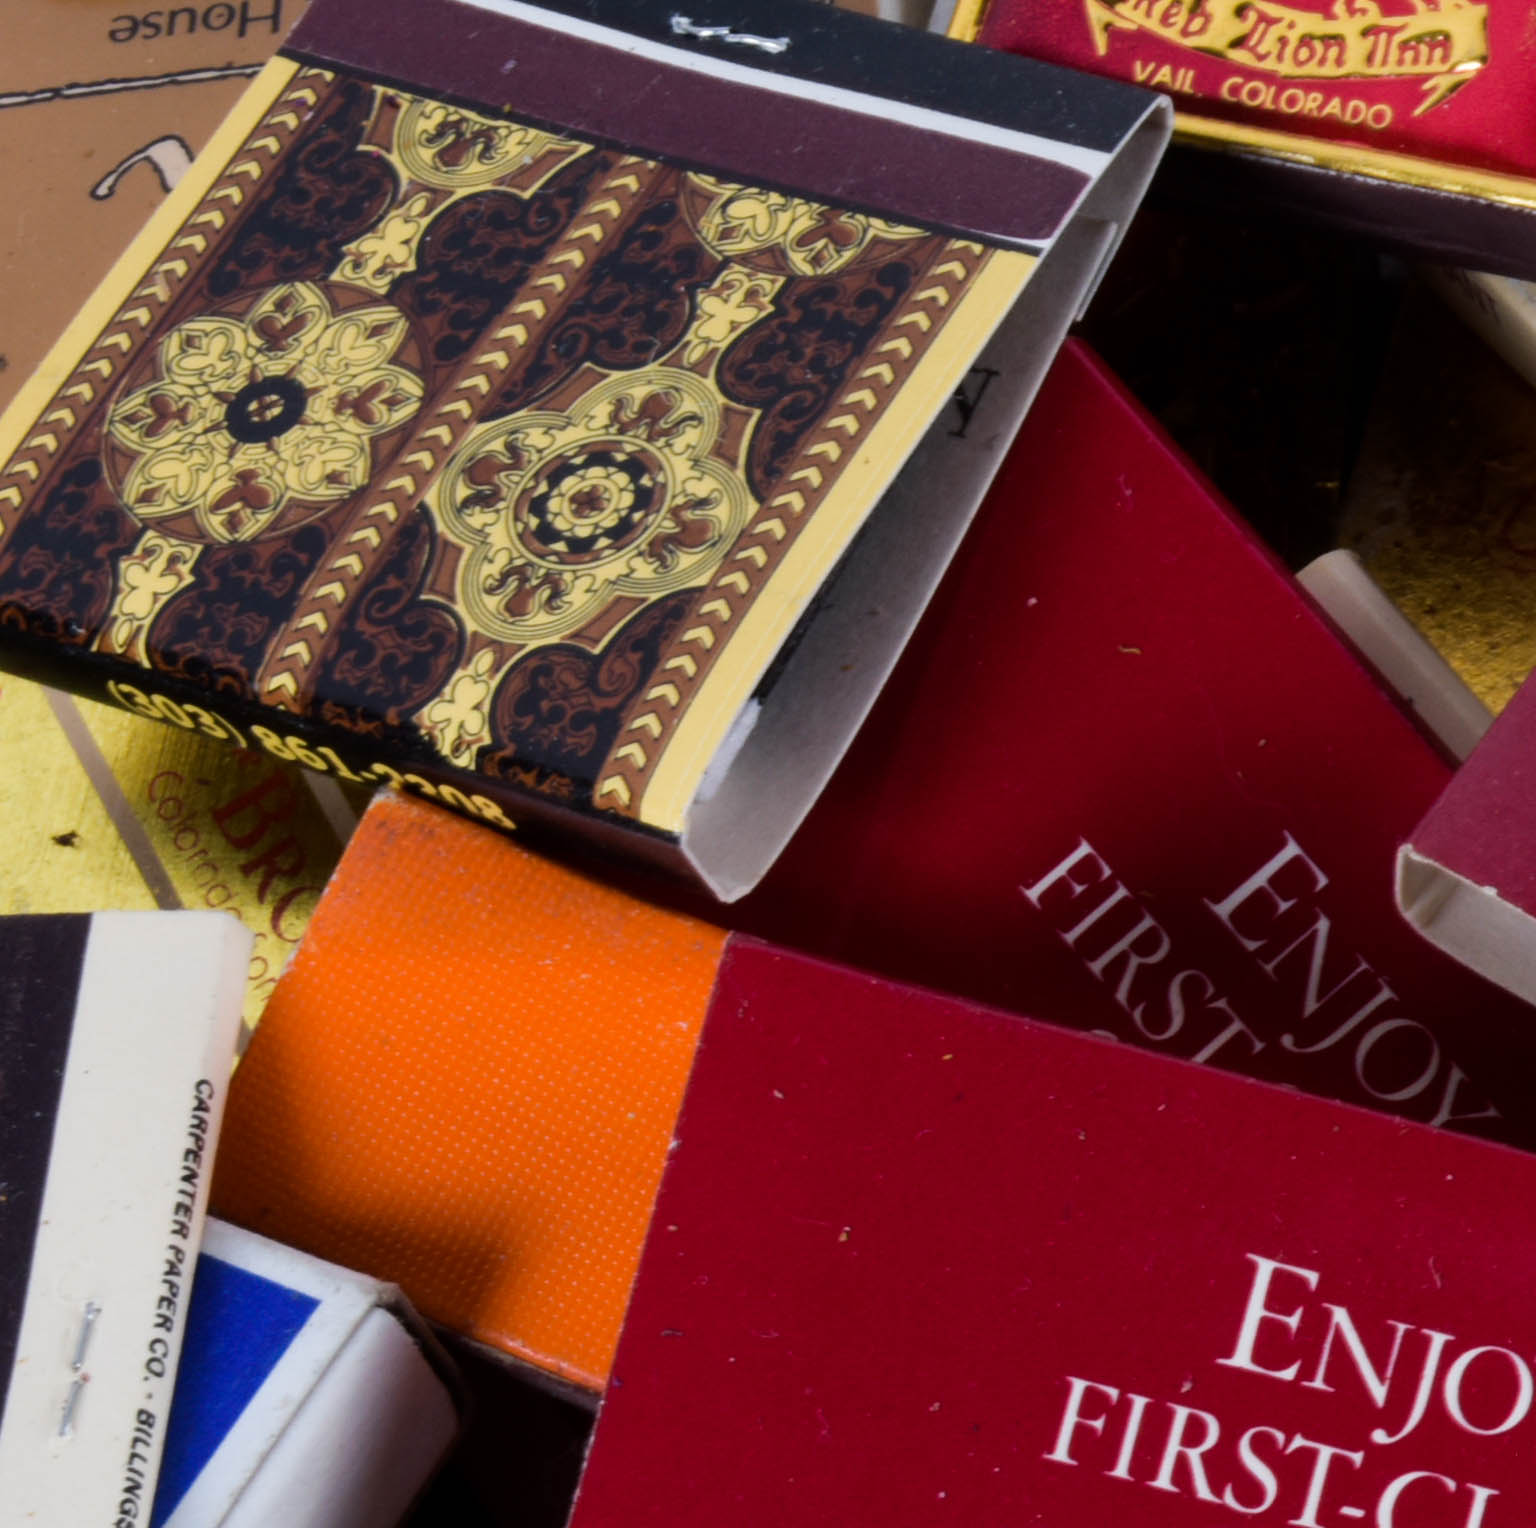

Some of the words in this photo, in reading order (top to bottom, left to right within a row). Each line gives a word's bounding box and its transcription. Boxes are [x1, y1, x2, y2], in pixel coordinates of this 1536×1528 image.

[108, 0, 282, 43] House
[1222, 76, 1394, 130] COLORADO
[1203, 829, 1502, 1129] ENJOY
[169, 1078, 215, 1240] CARPENTER
[152, 1243, 187, 1334] PAPER
[142, 1336, 170, 1383] CO.
